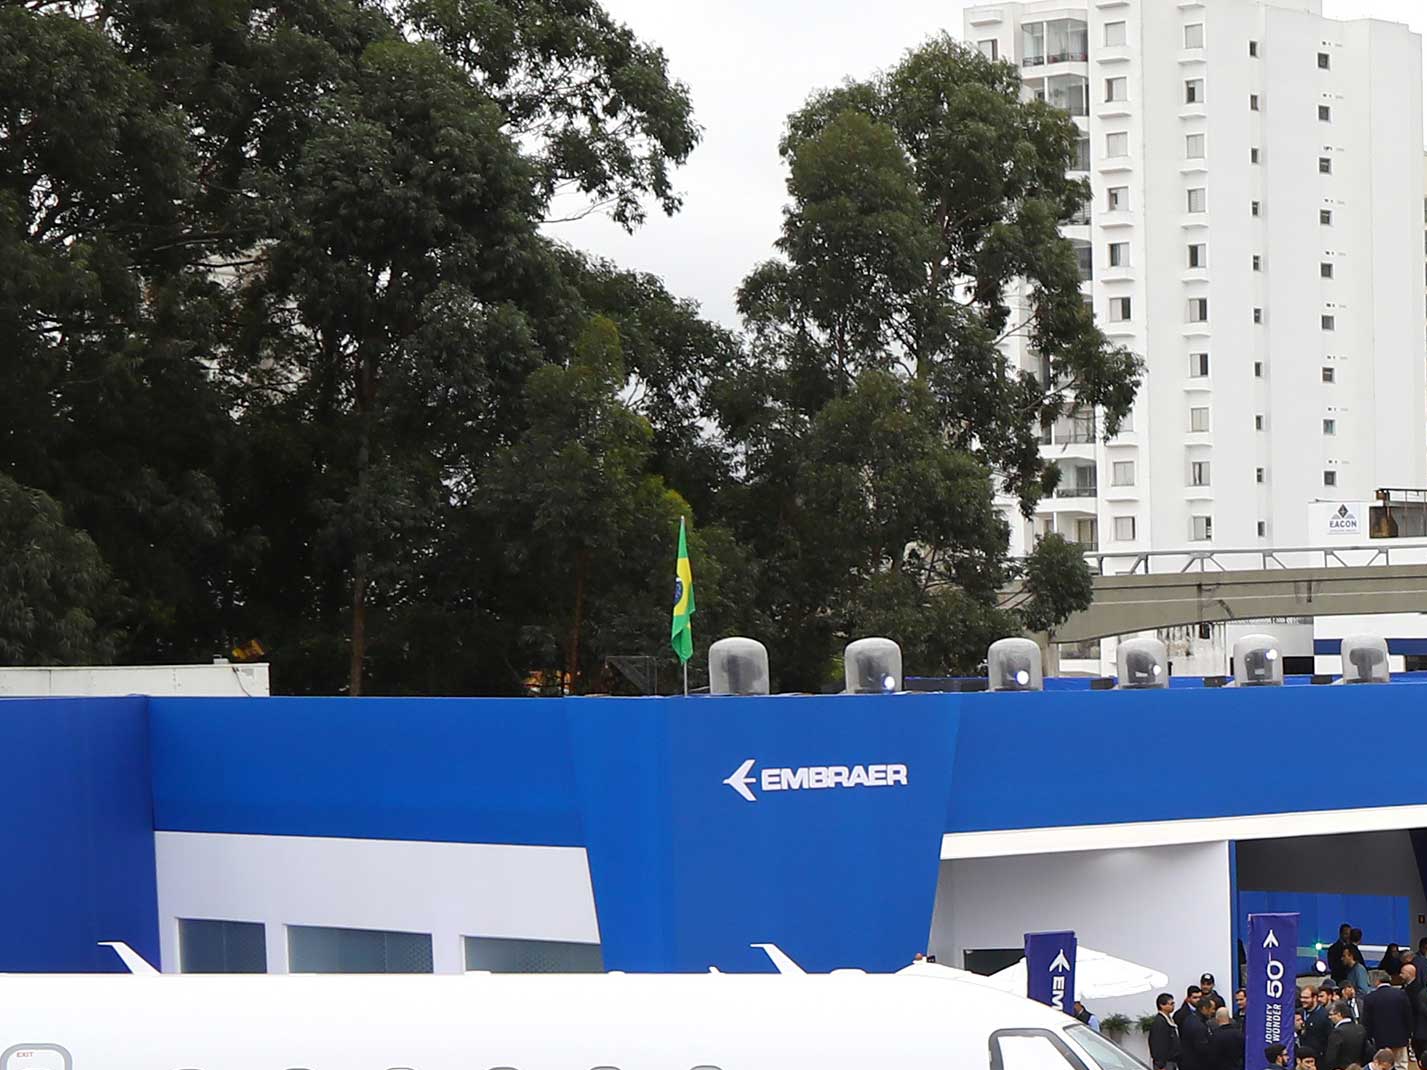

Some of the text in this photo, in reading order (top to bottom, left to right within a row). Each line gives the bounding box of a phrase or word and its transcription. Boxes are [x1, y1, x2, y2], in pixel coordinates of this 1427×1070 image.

[1329, 519, 1357, 528] EACON
[761, 764, 908, 791] EMBRAER
[1266, 959, 1285, 999] 50
[1264, 1003, 1274, 1044] JOURNEY
[1272, 1003, 1282, 1042] WONDER
